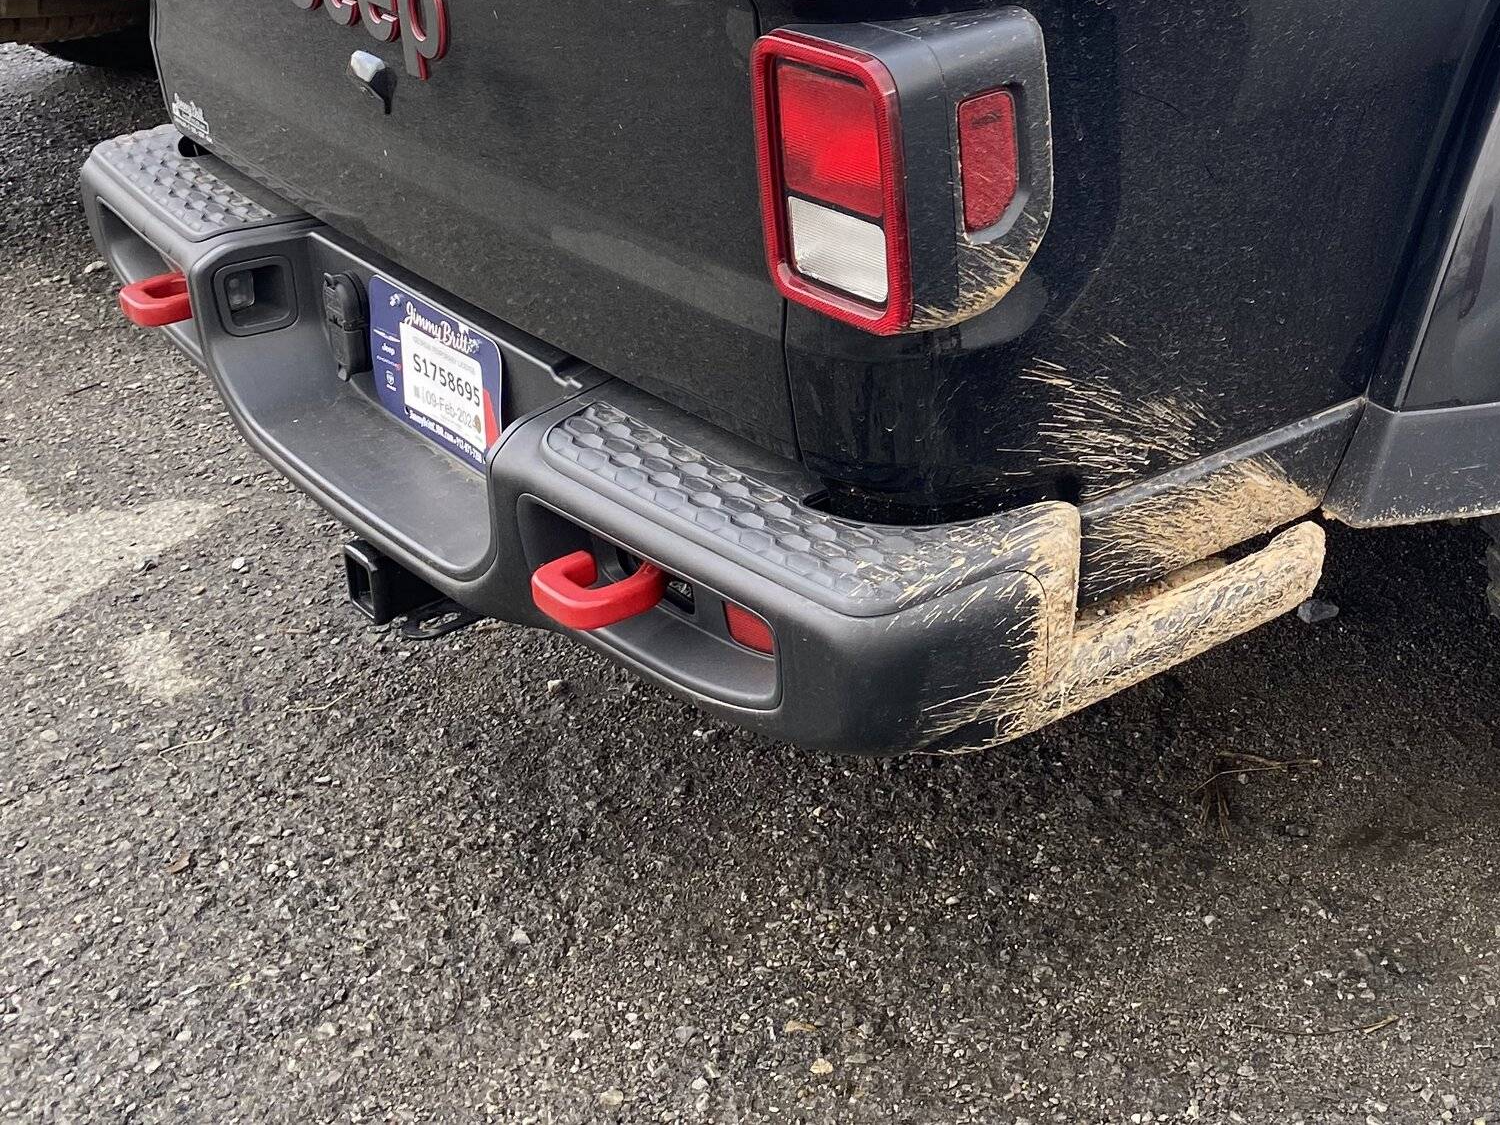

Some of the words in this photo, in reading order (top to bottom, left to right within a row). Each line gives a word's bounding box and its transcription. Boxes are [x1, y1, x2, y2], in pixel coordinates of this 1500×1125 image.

[381, 342, 396, 356] Jeep
[413, 353, 481, 407] S1758695
[425, 390, 480, 431] 09-Feb-202
